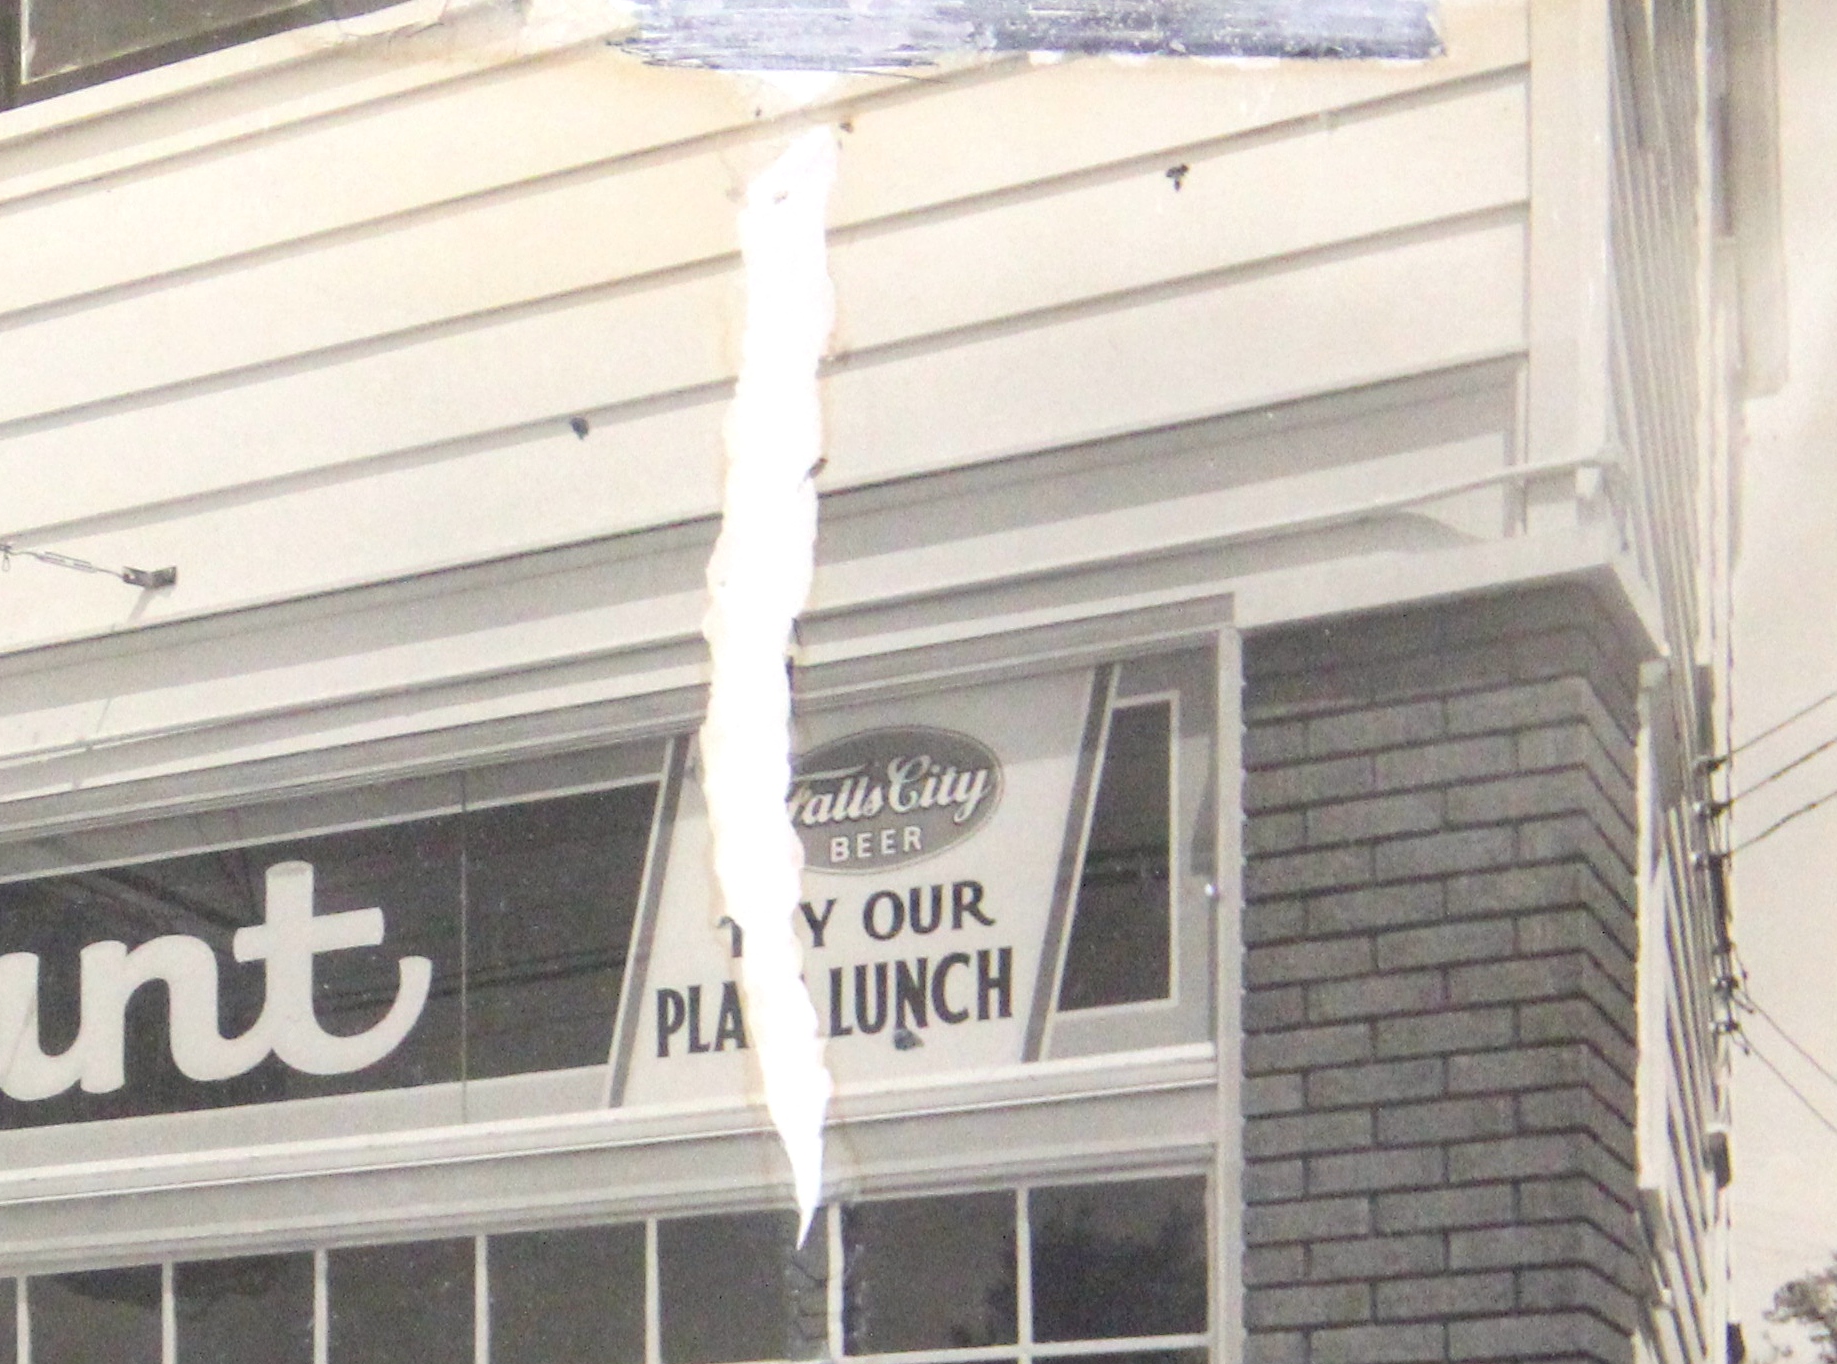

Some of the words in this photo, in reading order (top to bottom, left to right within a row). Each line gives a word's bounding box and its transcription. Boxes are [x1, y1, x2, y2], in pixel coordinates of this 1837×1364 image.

[887, 755, 992, 824] City
[829, 826, 922, 863] BEER
[717, 898, 837, 958] TY
[862, 880, 996, 941] OUR
[656, 975, 794, 1058] PLA
[829, 946, 1013, 1038] LUNCH
